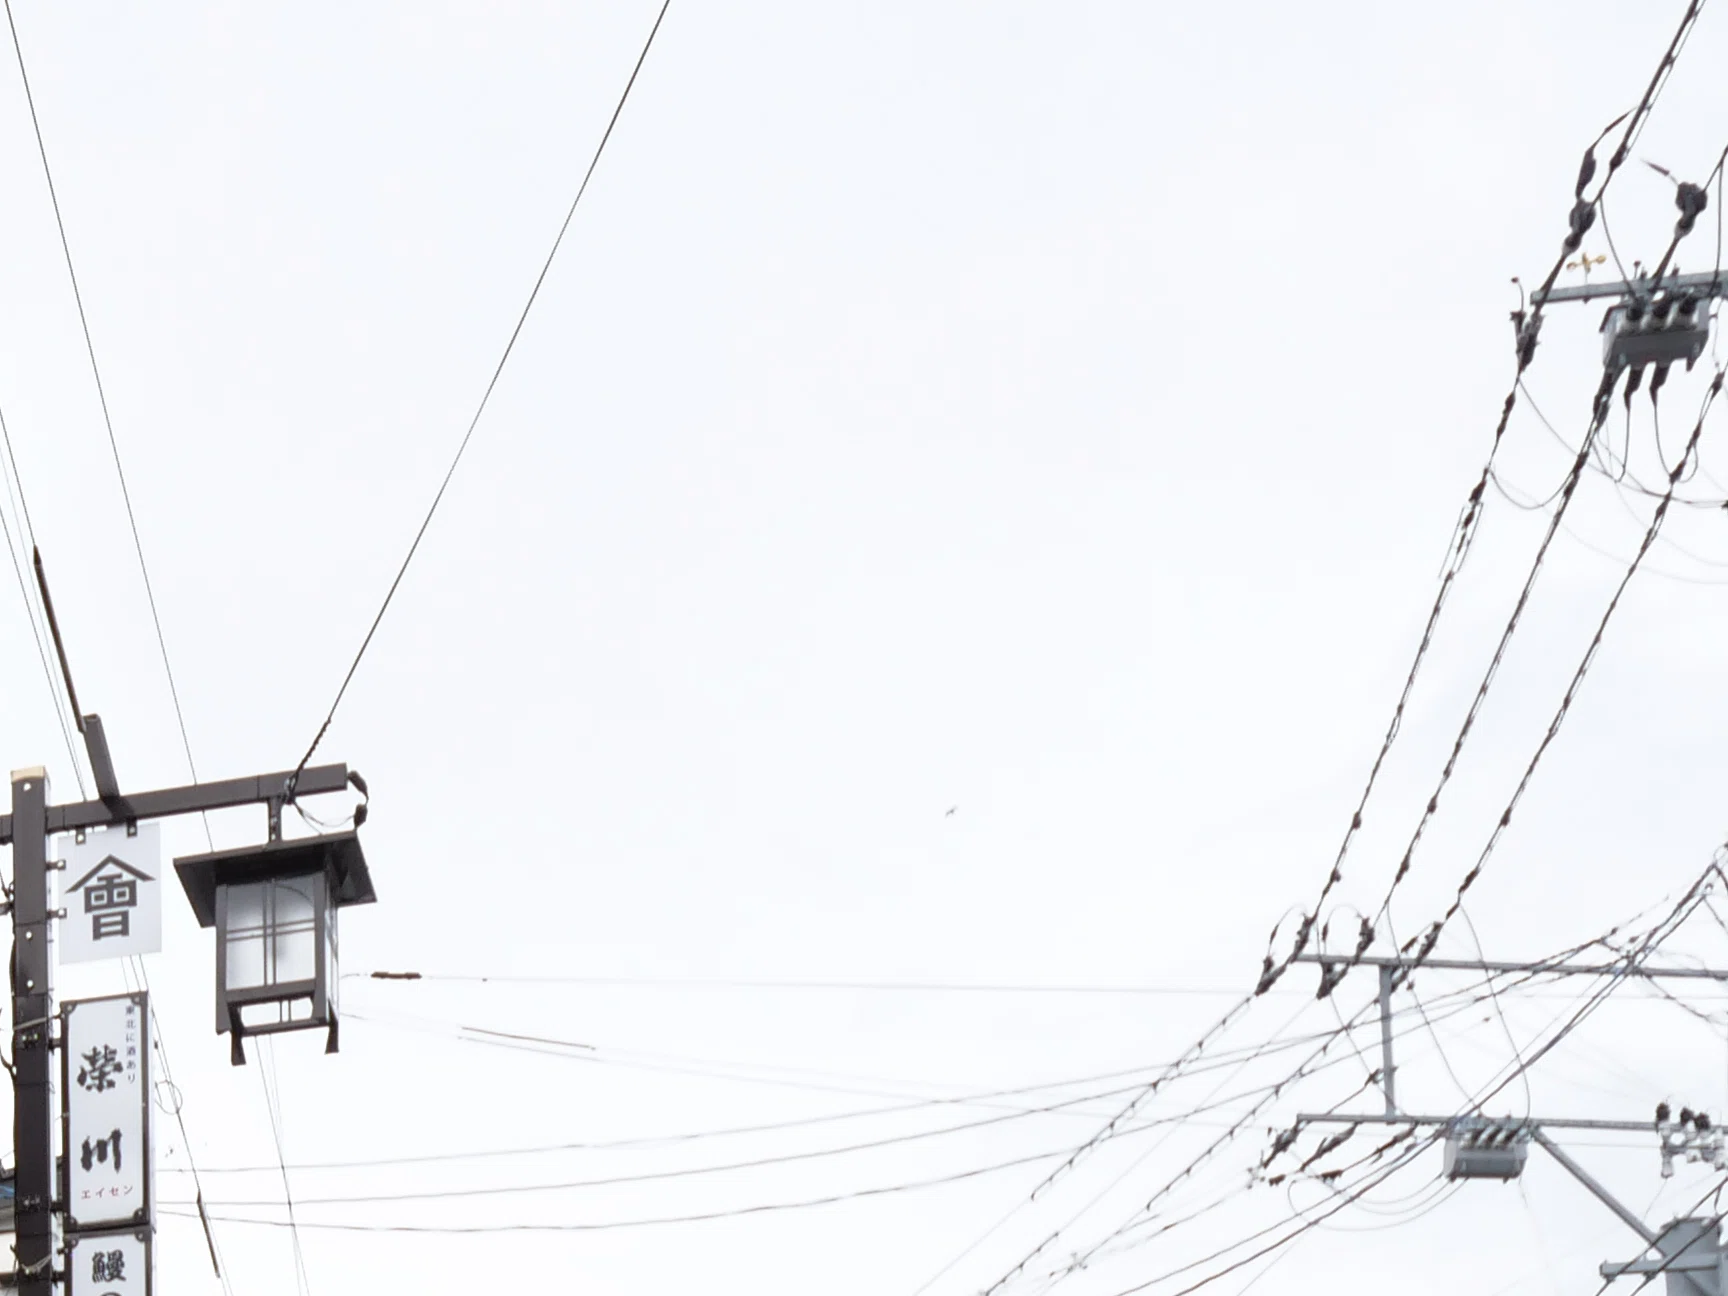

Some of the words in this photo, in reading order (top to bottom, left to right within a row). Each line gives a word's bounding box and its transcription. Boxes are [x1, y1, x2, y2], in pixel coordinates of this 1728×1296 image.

[125, 1005, 137, 1085] 東北に酒あり
[81, 1184, 135, 1201] エイセン
